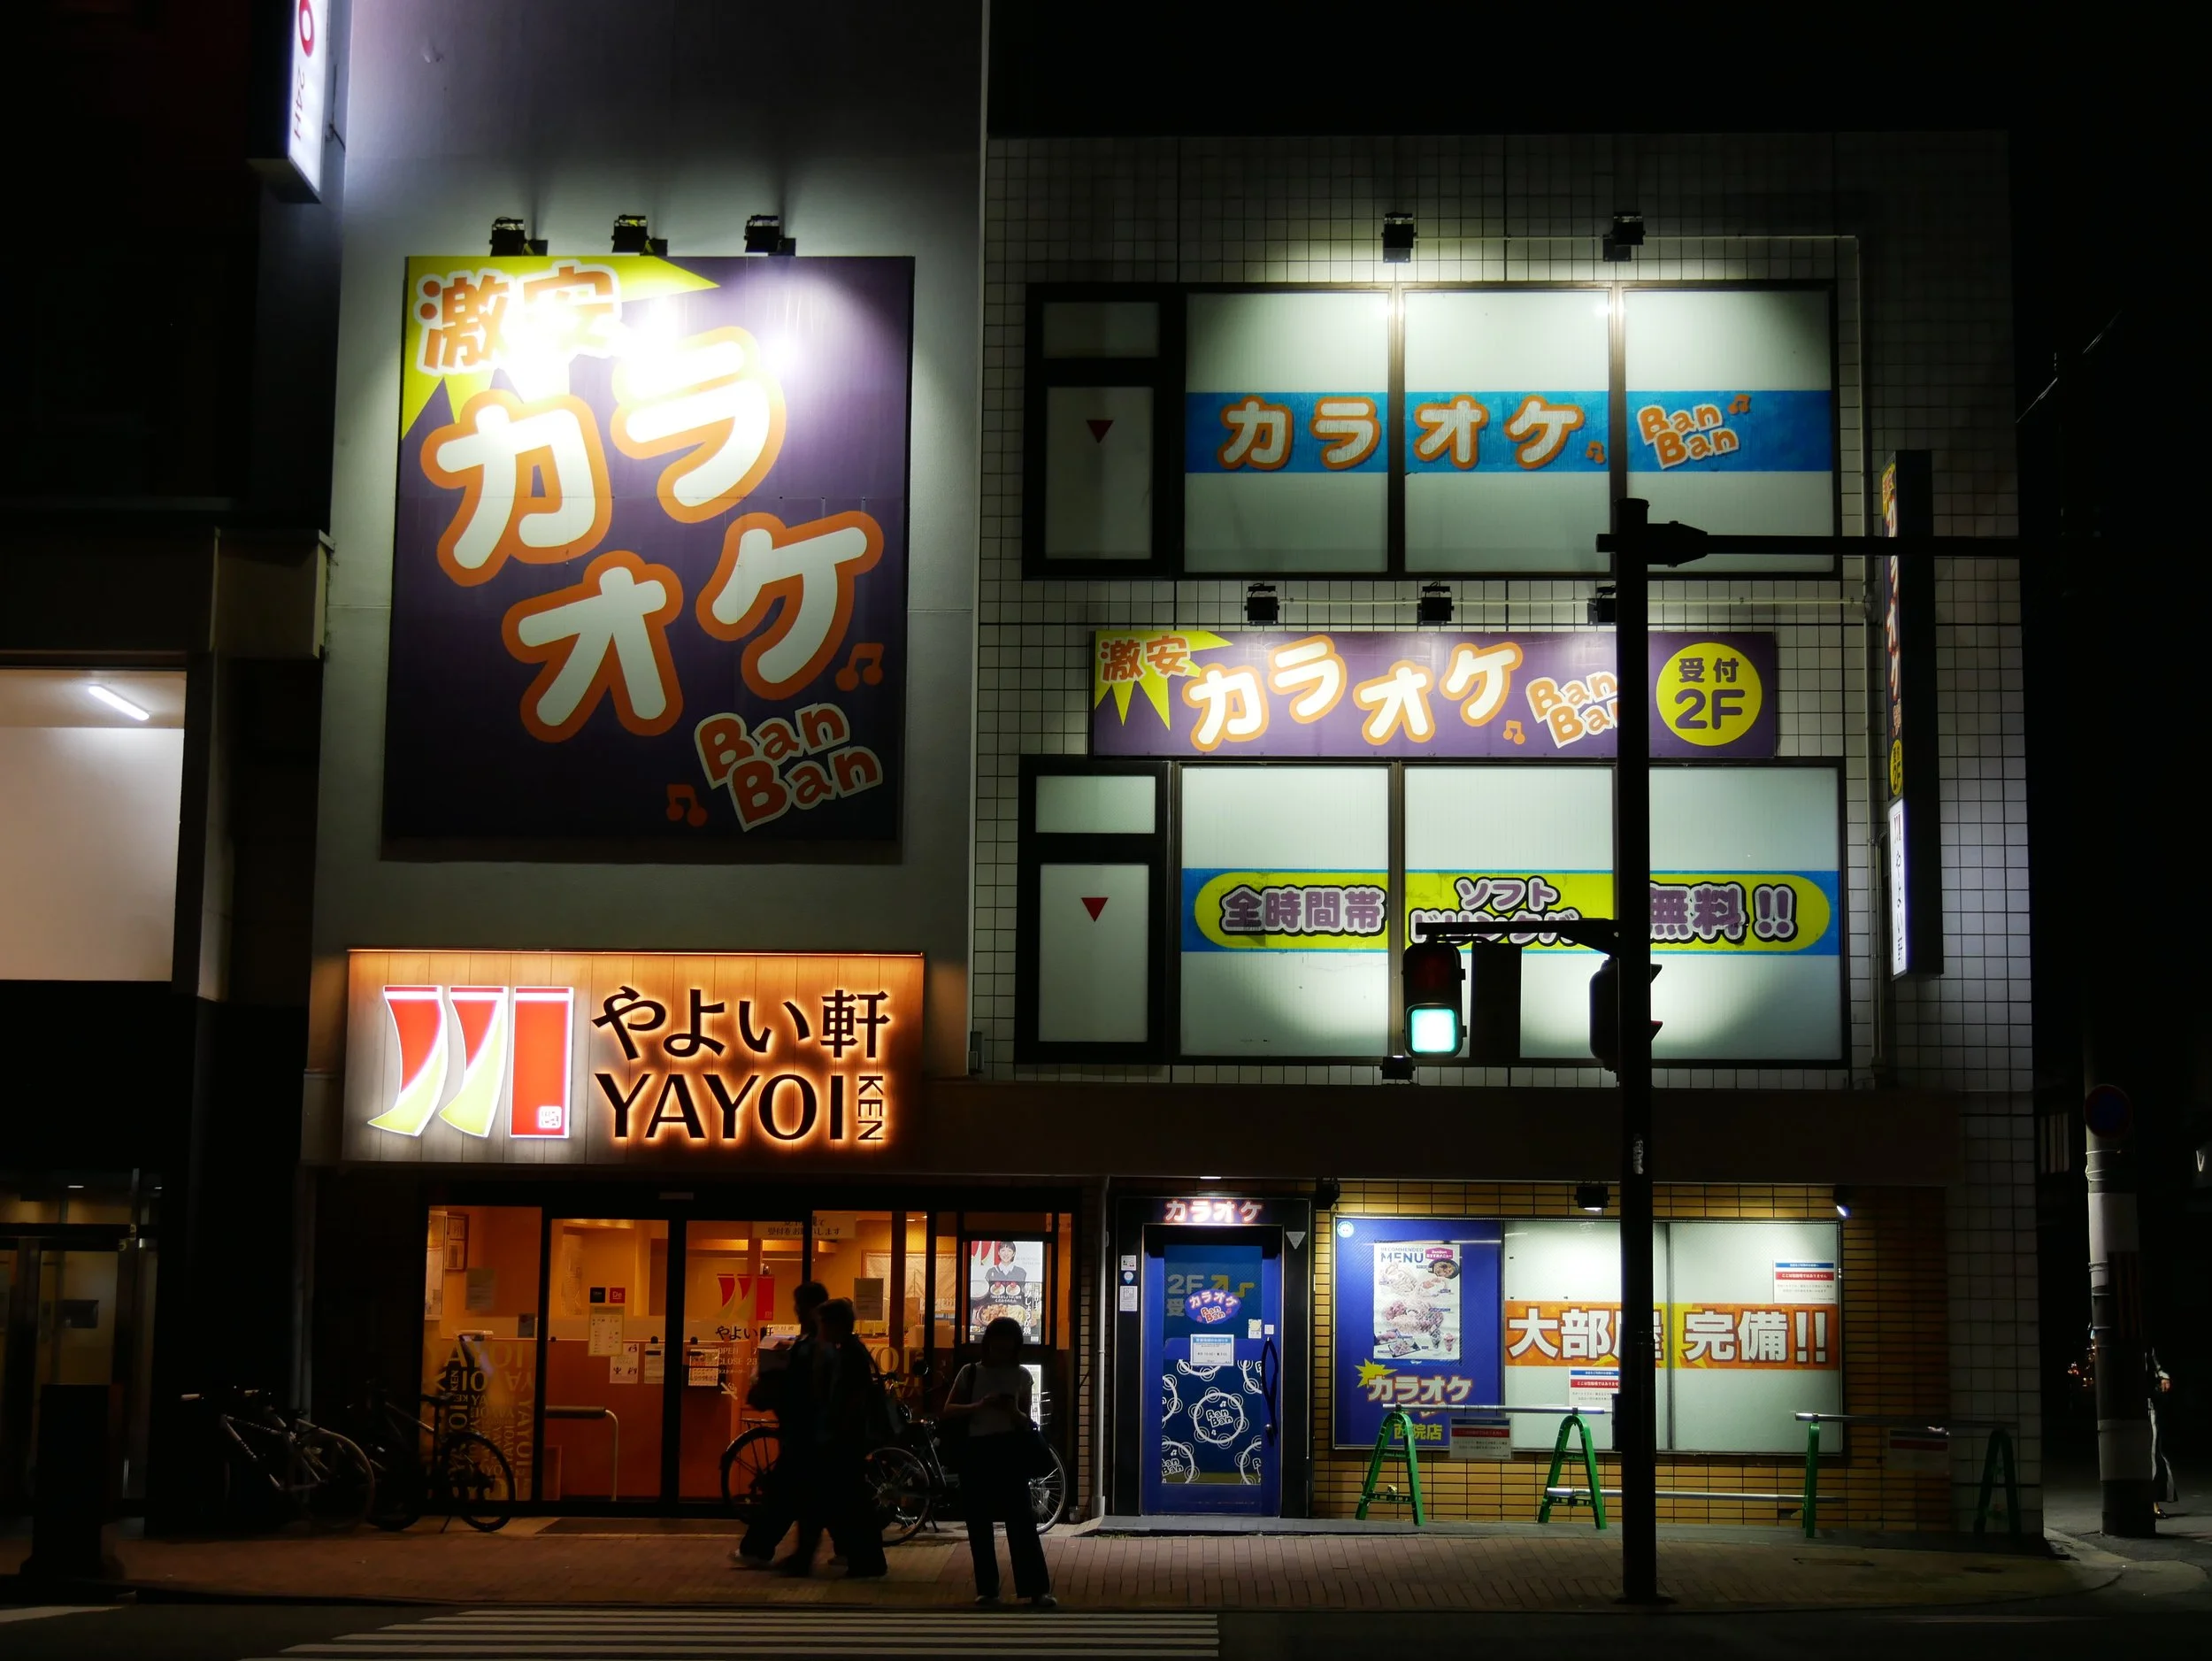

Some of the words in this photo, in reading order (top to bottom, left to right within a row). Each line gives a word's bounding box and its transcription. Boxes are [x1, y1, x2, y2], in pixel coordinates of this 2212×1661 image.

[419, 263, 619, 372] 激安
[1218, 395, 1585, 471] カラオケ
[1637, 404, 1723, 445] Ban
[1652, 427, 1740, 469] Ban
[1100, 636, 1191, 681] 激安
[1678, 657, 1738, 683] 受付
[1183, 635, 1522, 751] カラオケ
[1526, 673, 1617, 722] Ban
[1674, 688, 1745, 730] 2F
[695, 704, 850, 788] Ban
[726, 747, 883, 830] Ban
[1222, 886, 1386, 935] 全時間帯
[1455, 877, 1559, 911] ソフト
[591, 986, 892, 1061] やよい軒
[595, 1073, 845, 1141] YAYOI
[857, 1074, 884, 1141] KEN
[1164, 1199, 1263, 1223] カラオケ
[1380, 1252, 1424, 1264] MENU
[1167, 1273, 1204, 1295] 2F
[1188, 1290, 1239, 1309] カラオケ
[1201, 1306, 1222, 1318] Ban
[1205, 1311, 1226, 1323] Ban
[1367, 1374, 1472, 1402] カラオケ
[1206, 1410, 1229, 1420] Ban
[1210, 1416, 1233, 1427] Ban
[1162, 1457, 1180, 1467] an
